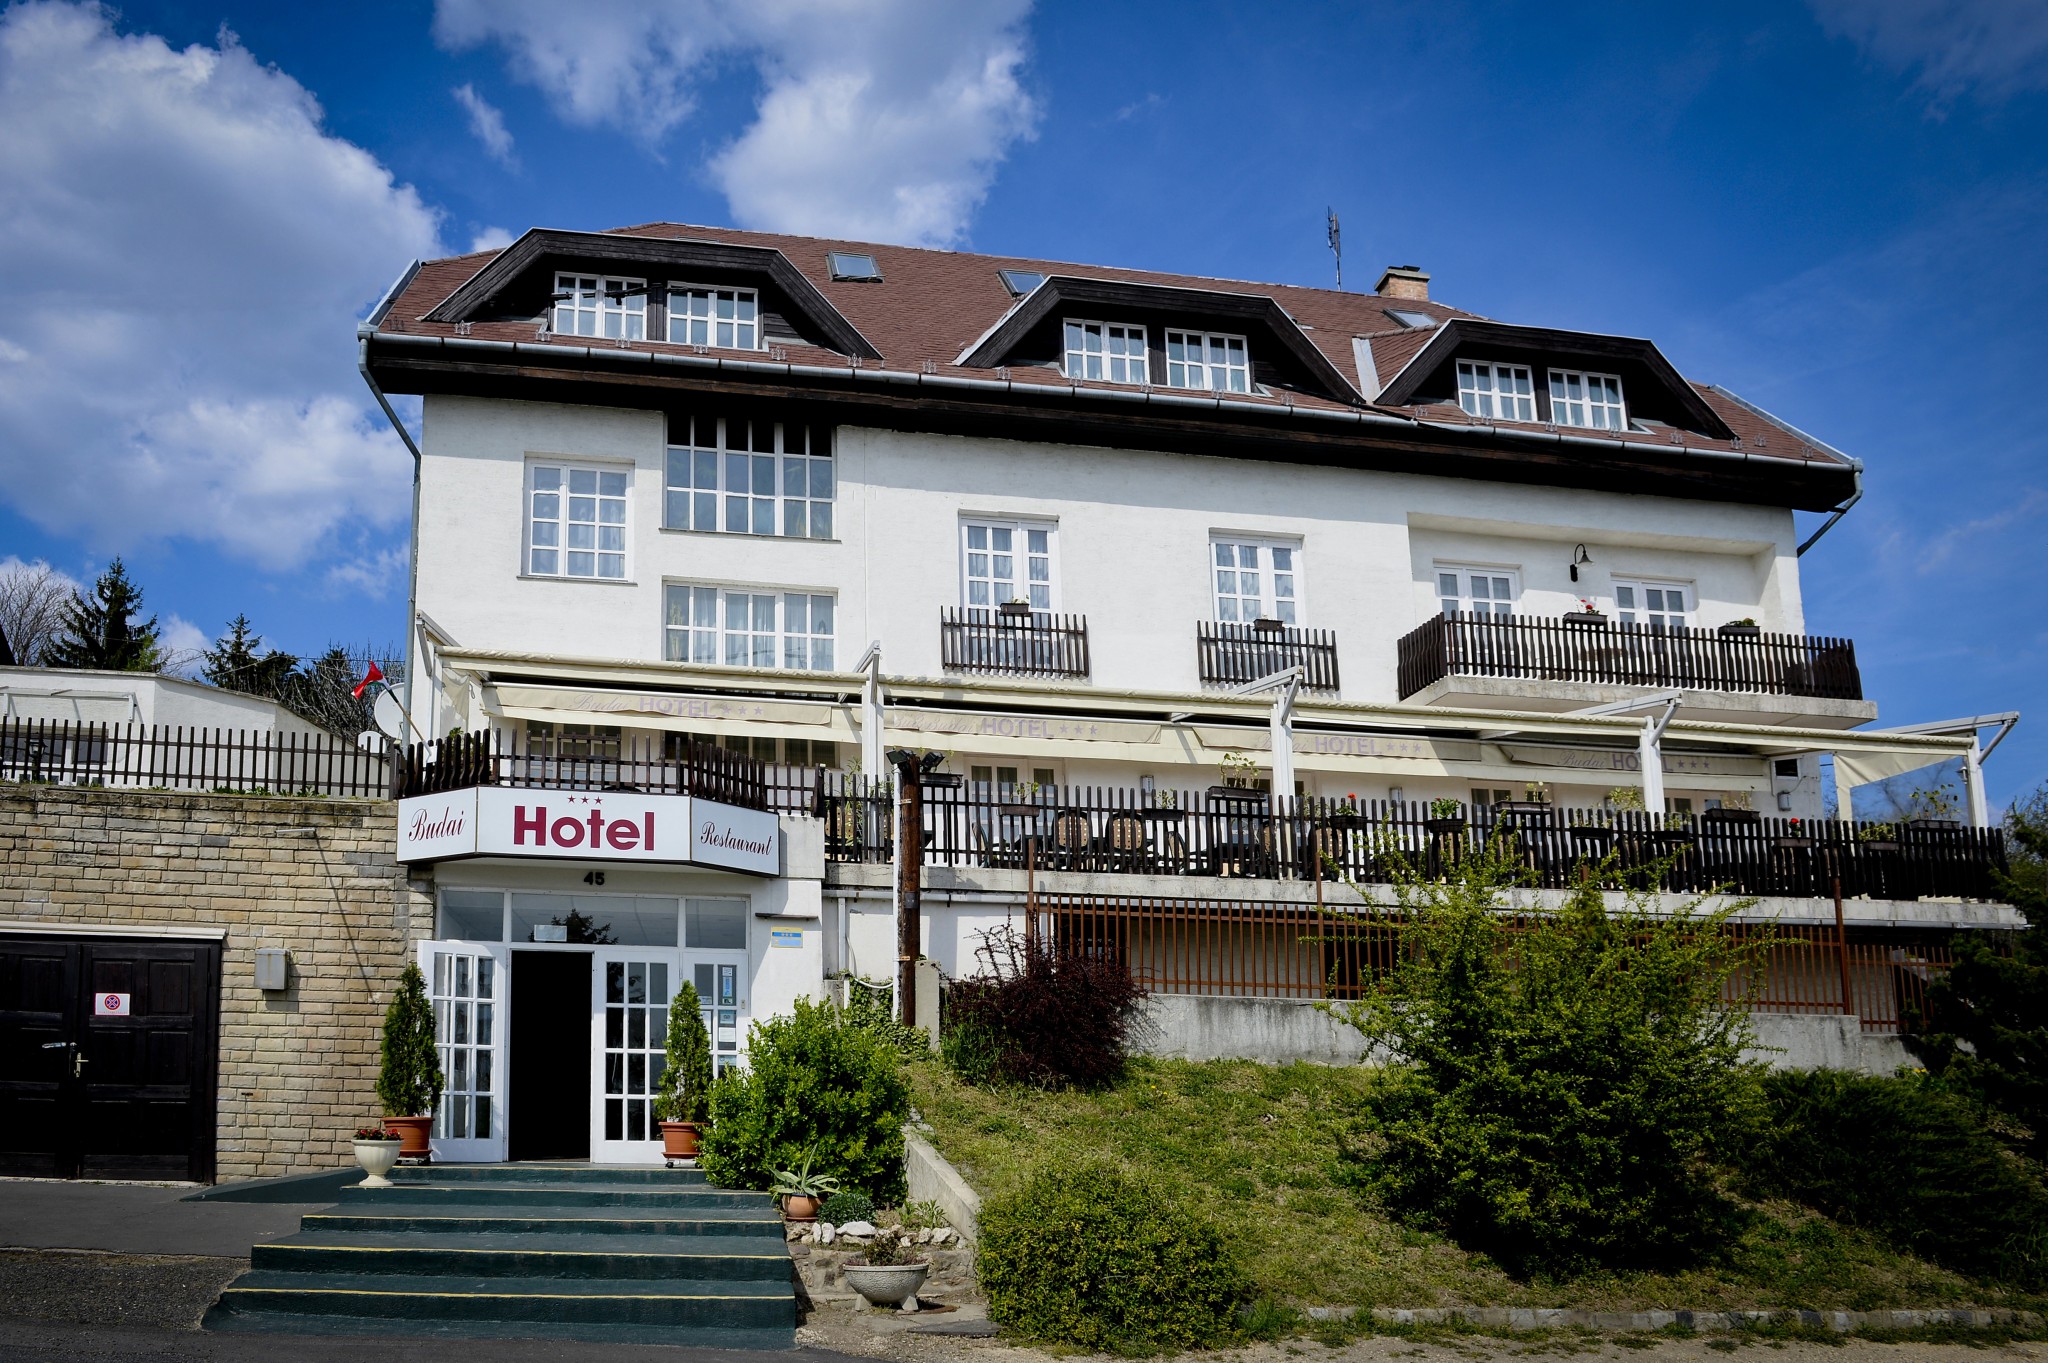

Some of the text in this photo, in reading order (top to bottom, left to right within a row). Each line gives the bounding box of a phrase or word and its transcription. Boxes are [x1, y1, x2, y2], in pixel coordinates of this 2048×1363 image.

[639, 696, 716, 718] HOTEL
[982, 717, 1055, 738] HOTEL
[1315, 735, 1383, 755] HOTEL
[1611, 753, 1674, 772] HOL
[408, 806, 466, 841] Budai
[513, 805, 655, 851] Hotel
[700, 821, 772, 856] Restaurant
[583, 871, 606, 886] 45
